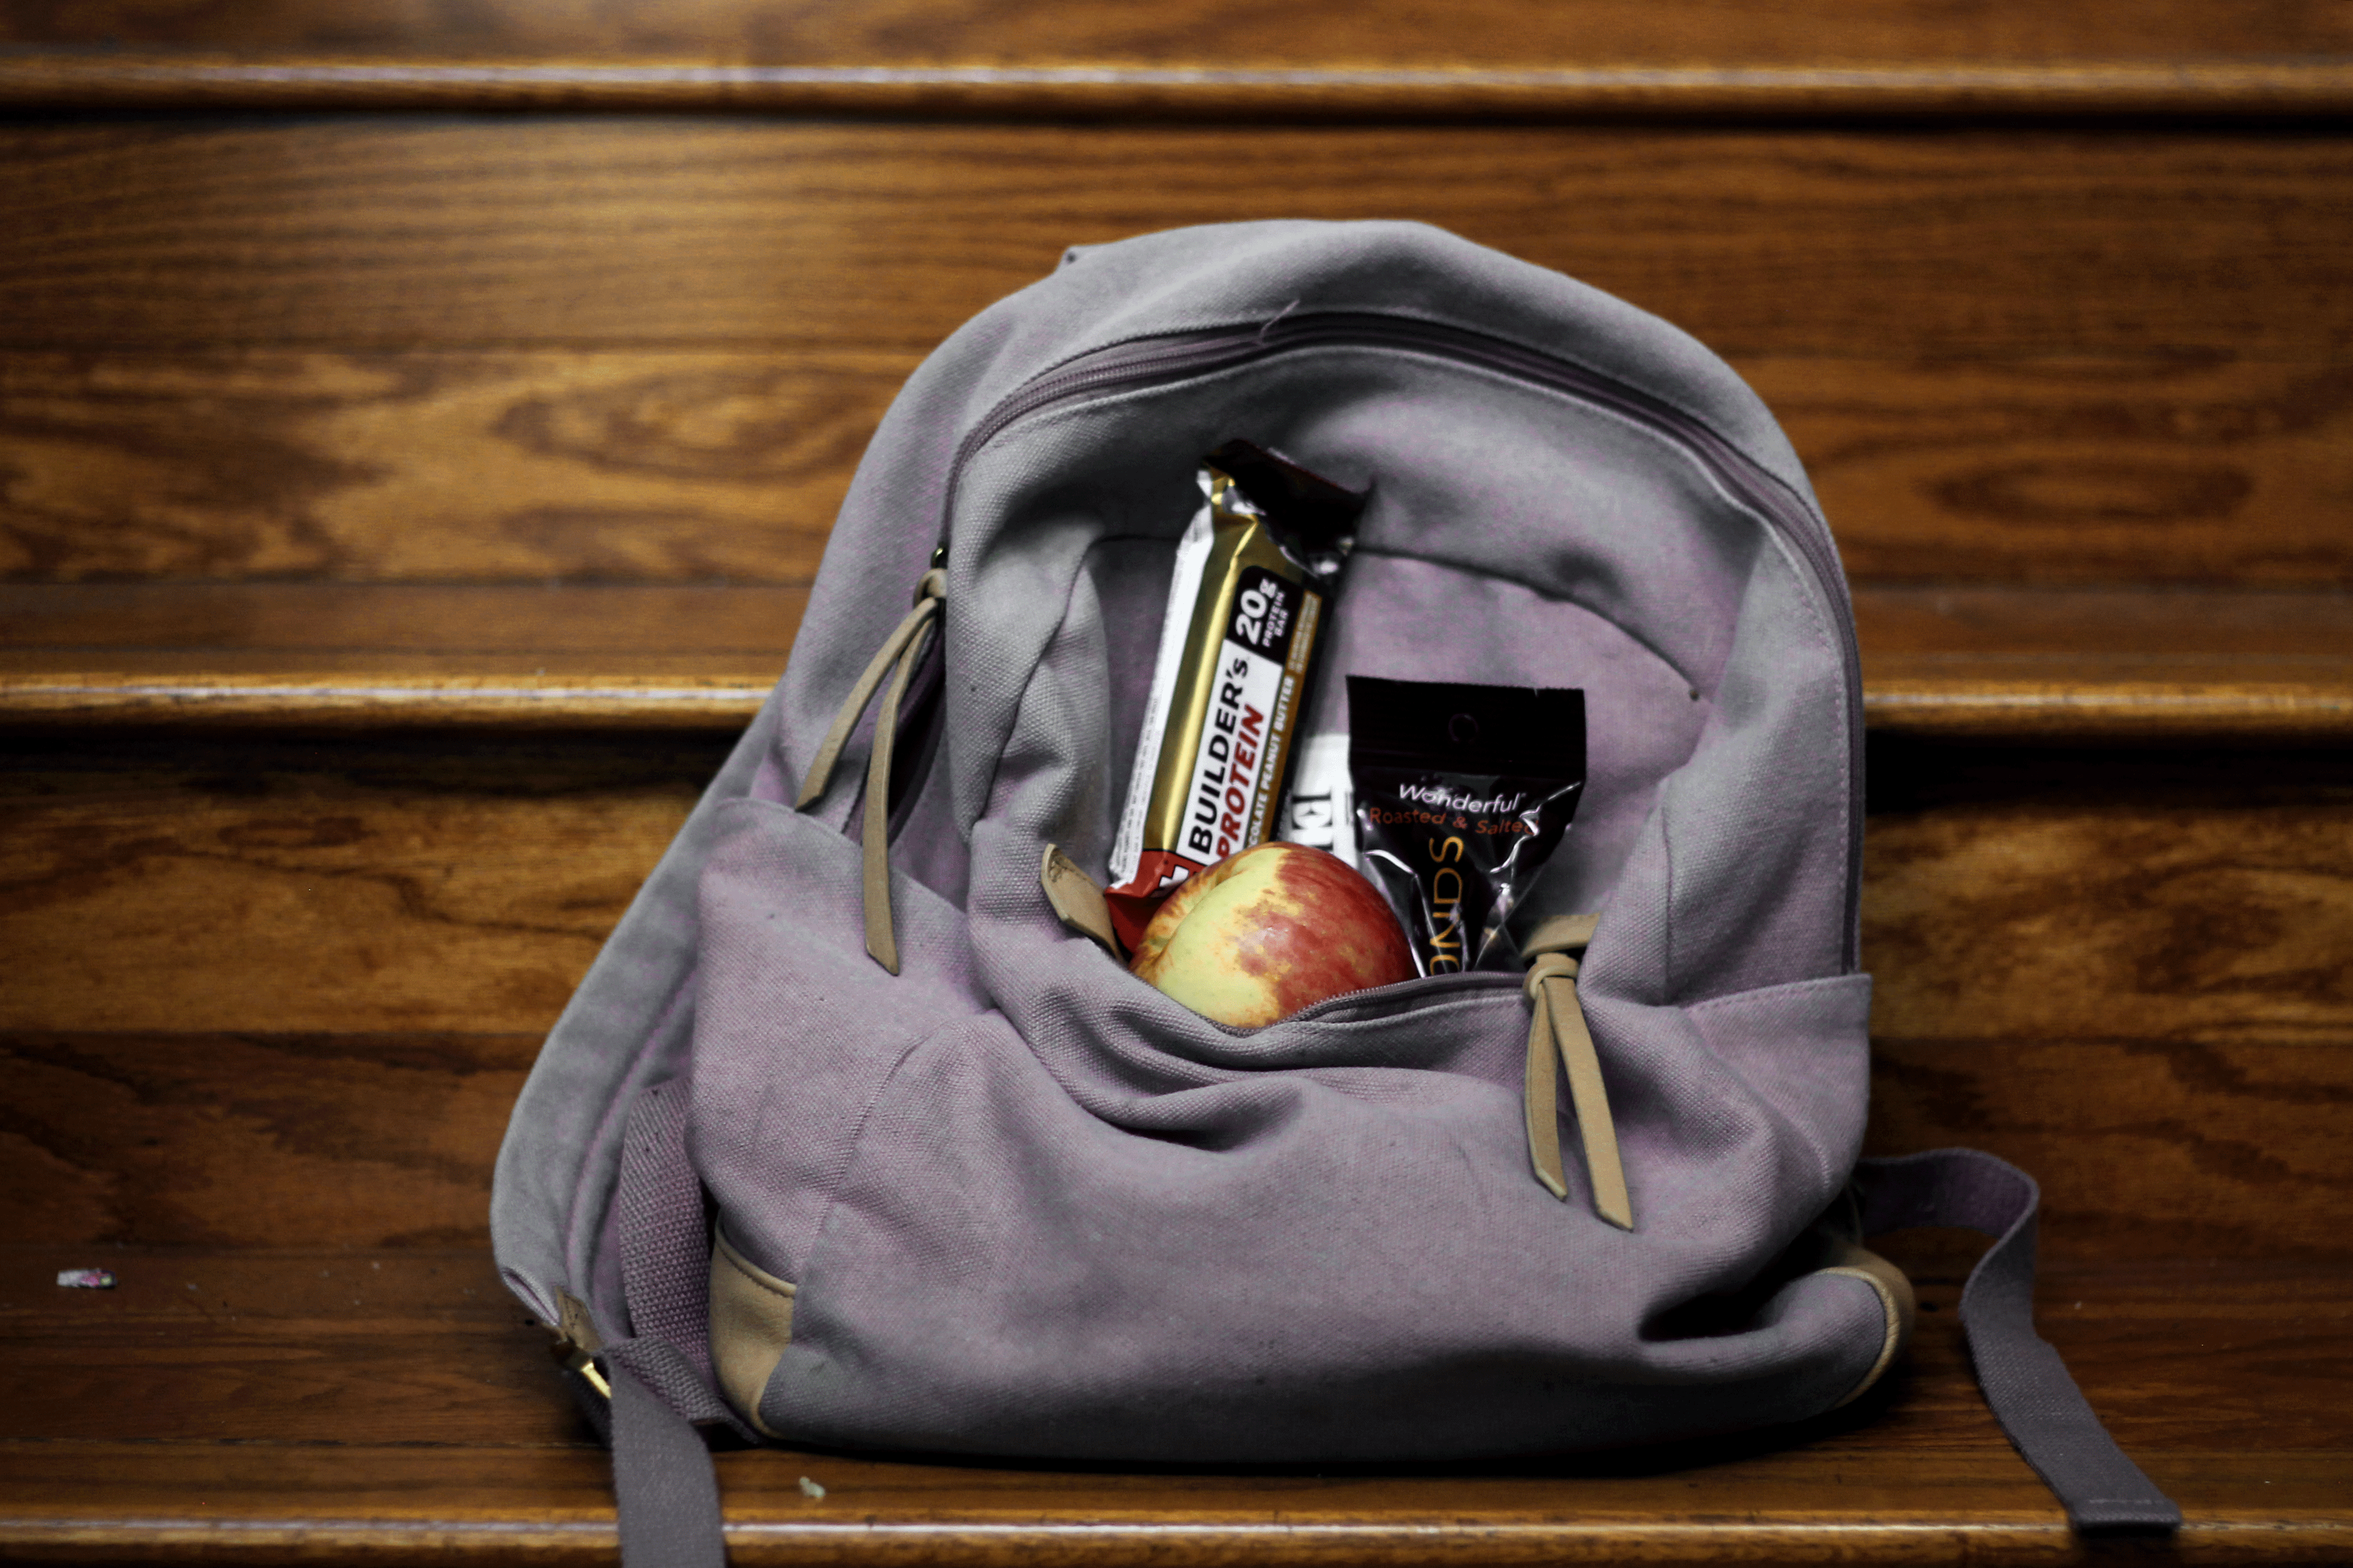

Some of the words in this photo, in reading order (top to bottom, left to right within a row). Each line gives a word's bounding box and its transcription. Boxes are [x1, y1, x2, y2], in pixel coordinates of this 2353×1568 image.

[1236, 578, 1277, 644] 20g
[1262, 592, 1284, 647] PROTEIN
[1275, 610, 1288, 636] BAR
[1216, 704, 1264, 858] PROTEIN
[1250, 791, 1269, 846] COLATE
[1261, 733, 1280, 788] PEANUT
[1274, 677, 1295, 731] BUTTER
[1369, 807, 1447, 824] Roasted
[1453, 816, 1468, 830] &
[1399, 784, 1521, 813] Wonderful
